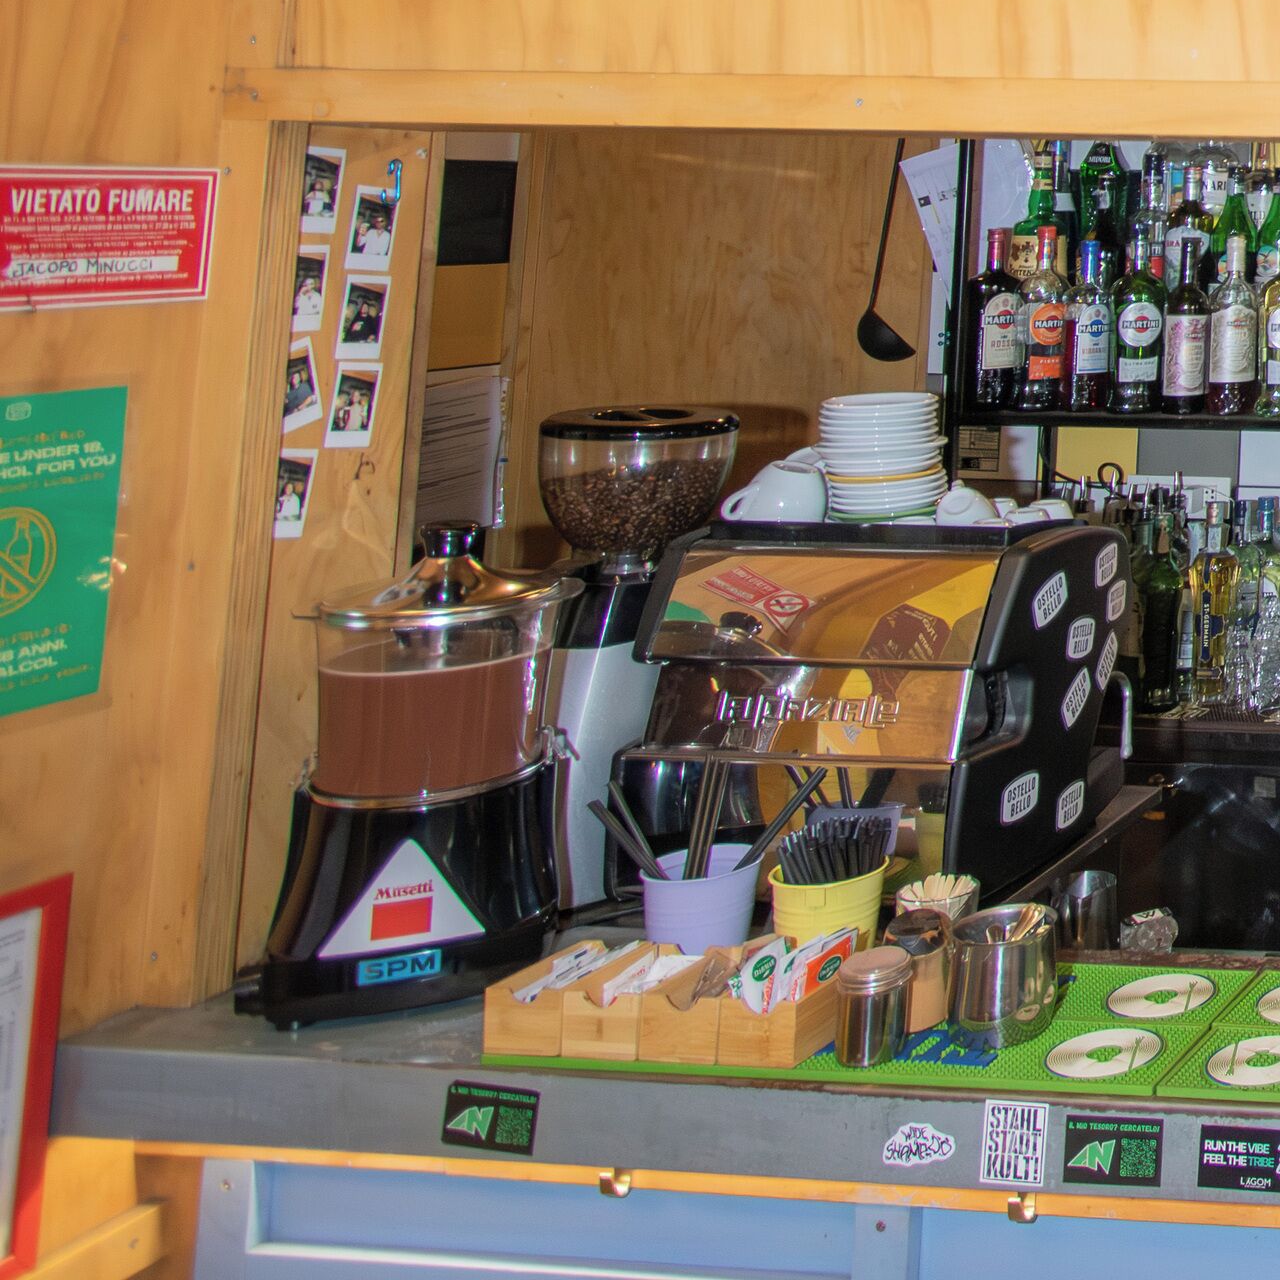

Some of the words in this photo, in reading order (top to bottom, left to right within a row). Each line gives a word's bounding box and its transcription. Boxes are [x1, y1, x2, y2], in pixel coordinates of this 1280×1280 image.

[11, 188, 101, 213] VIETATO
[108, 189, 193, 213] FUMARE
[13, 260, 77, 278] JACOPO
[87, 258, 152, 274] MINUCCI
[1122, 320, 1160, 328] MARTINI
[1037, 576, 1063, 610] OSTELLO
[1043, 596, 1062, 620] BELLO
[1072, 622, 1093, 639] OSTELLO
[1007, 777, 1036, 803] OSTELLO
[1010, 795, 1031, 817] BELLO
[373, 879, 433, 901] Musetti
[365, 953, 437, 981] SPM
[1204, 1140, 1226, 1151] RUN
[1227, 1141, 1247, 1153] THE
[1248, 1142, 1270, 1154] VIBE
[1204, 1153, 1226, 1164] FEEL
[1228, 1155, 1247, 1166] THE
[1248, 1156, 1275, 1168] TRIBE
